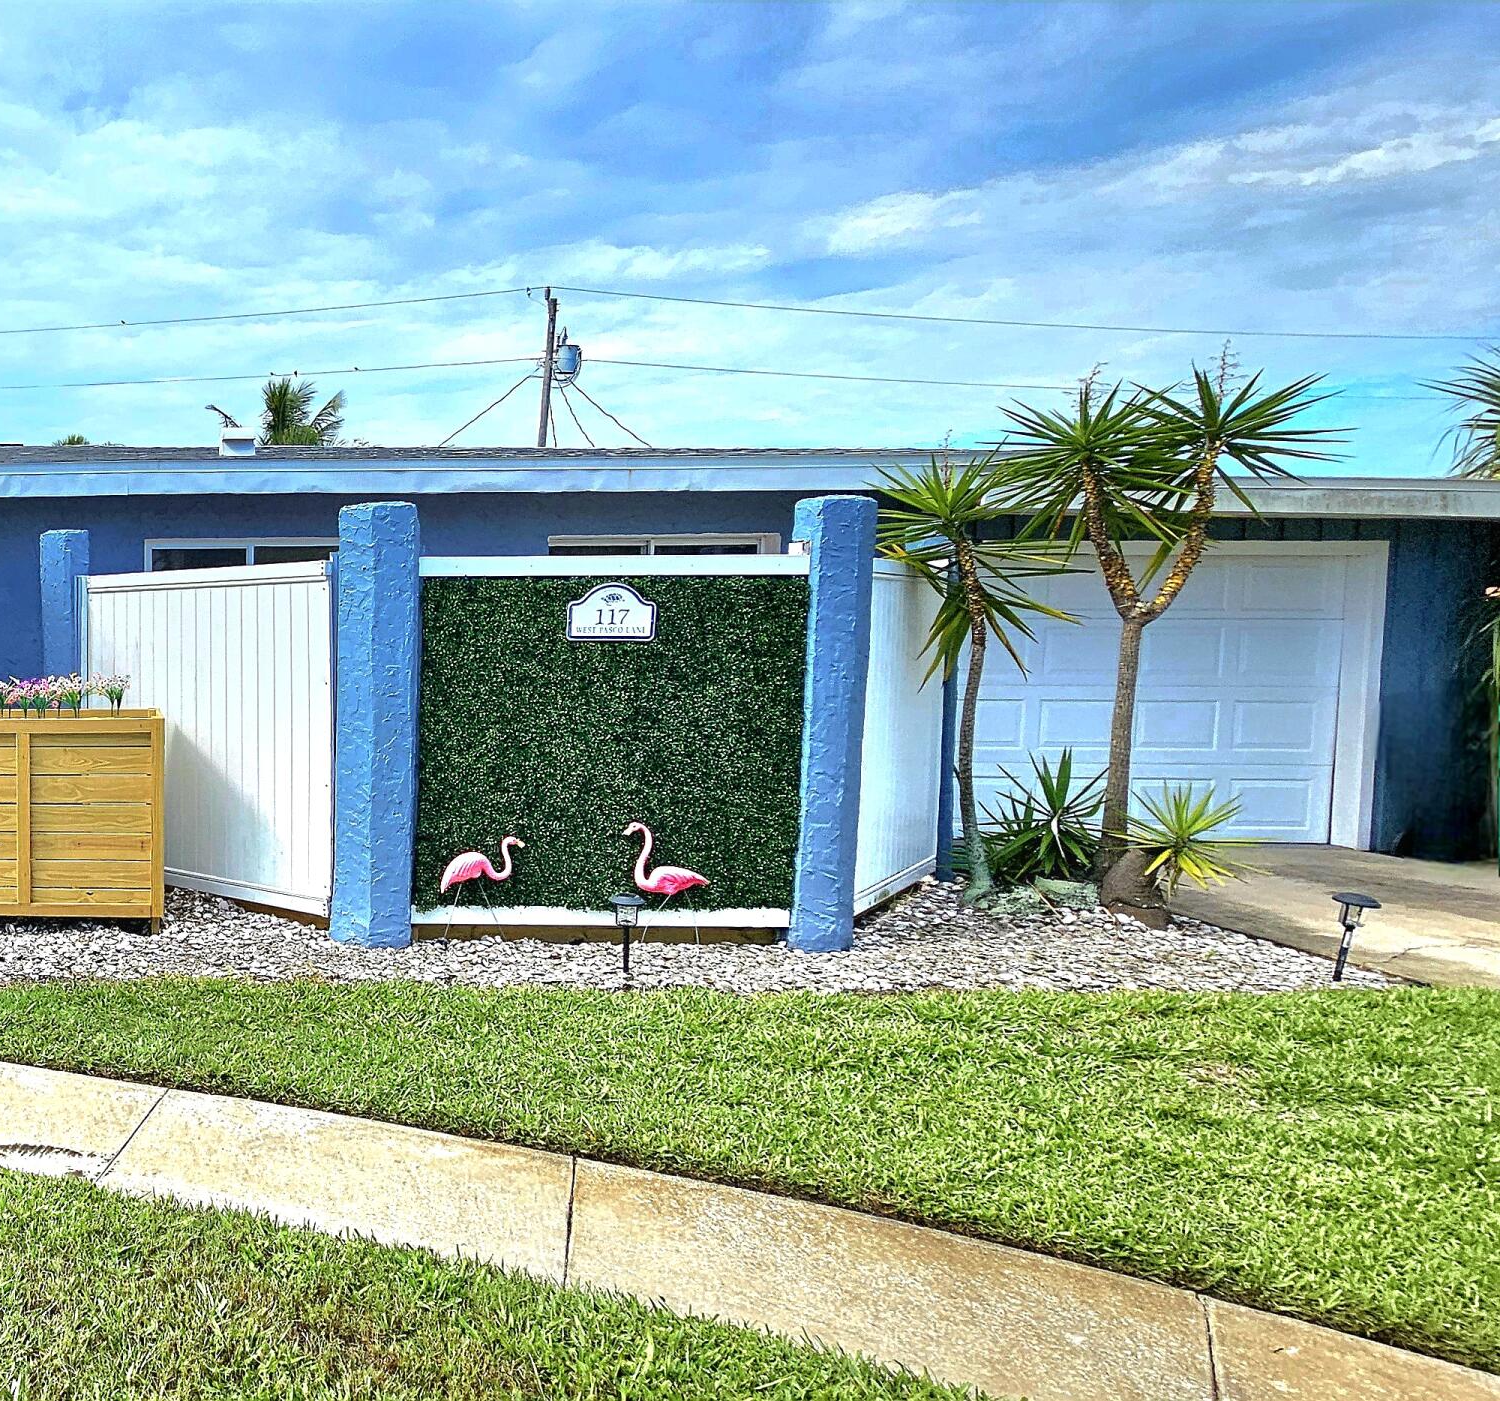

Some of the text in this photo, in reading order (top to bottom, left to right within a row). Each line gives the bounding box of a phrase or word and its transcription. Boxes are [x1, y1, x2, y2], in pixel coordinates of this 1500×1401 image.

[595, 609, 630, 625] 117
[576, 626, 596, 634] WEST
[599, 626, 624, 634] PASCO
